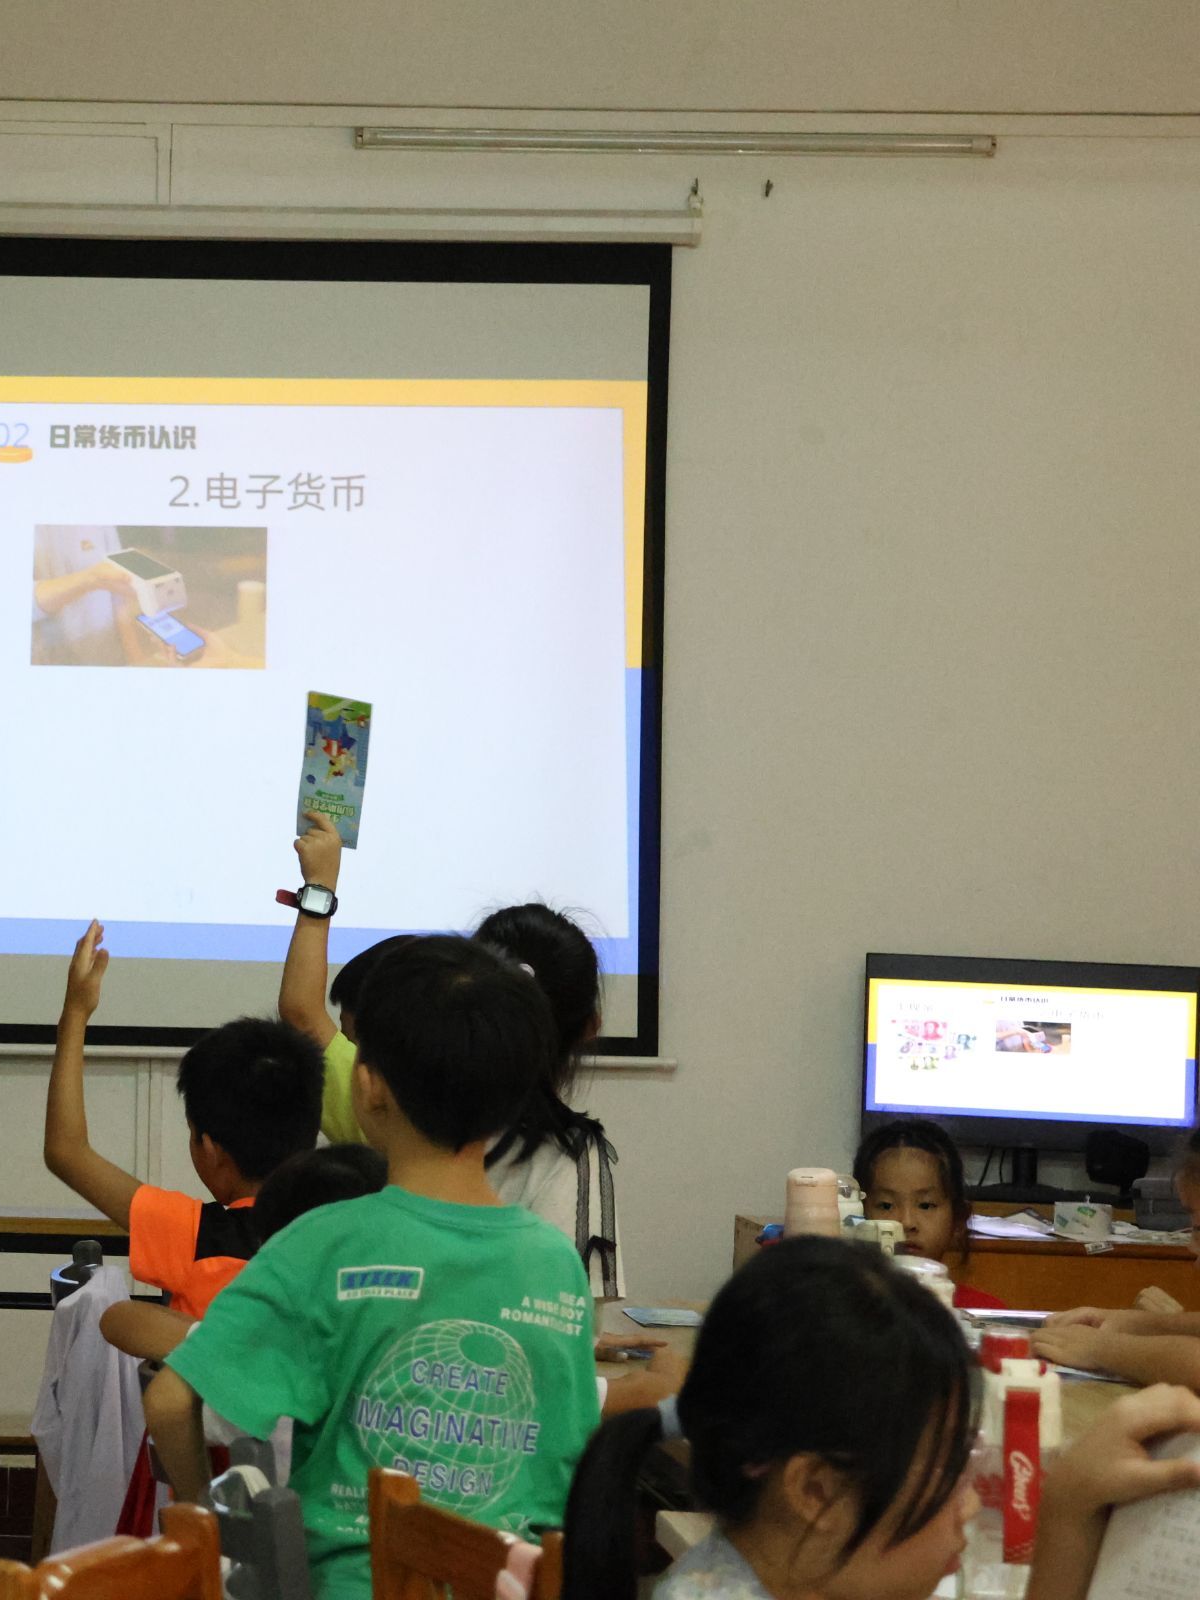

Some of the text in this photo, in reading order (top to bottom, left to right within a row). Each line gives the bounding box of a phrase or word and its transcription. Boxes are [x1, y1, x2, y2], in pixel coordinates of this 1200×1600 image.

[49, 424, 197, 449] 日常货币认识
[168, 472, 366, 512] 2.电子货币
[411, 1359, 509, 1396] CREATE
[356, 1396, 540, 1454] MAGINATIVE
